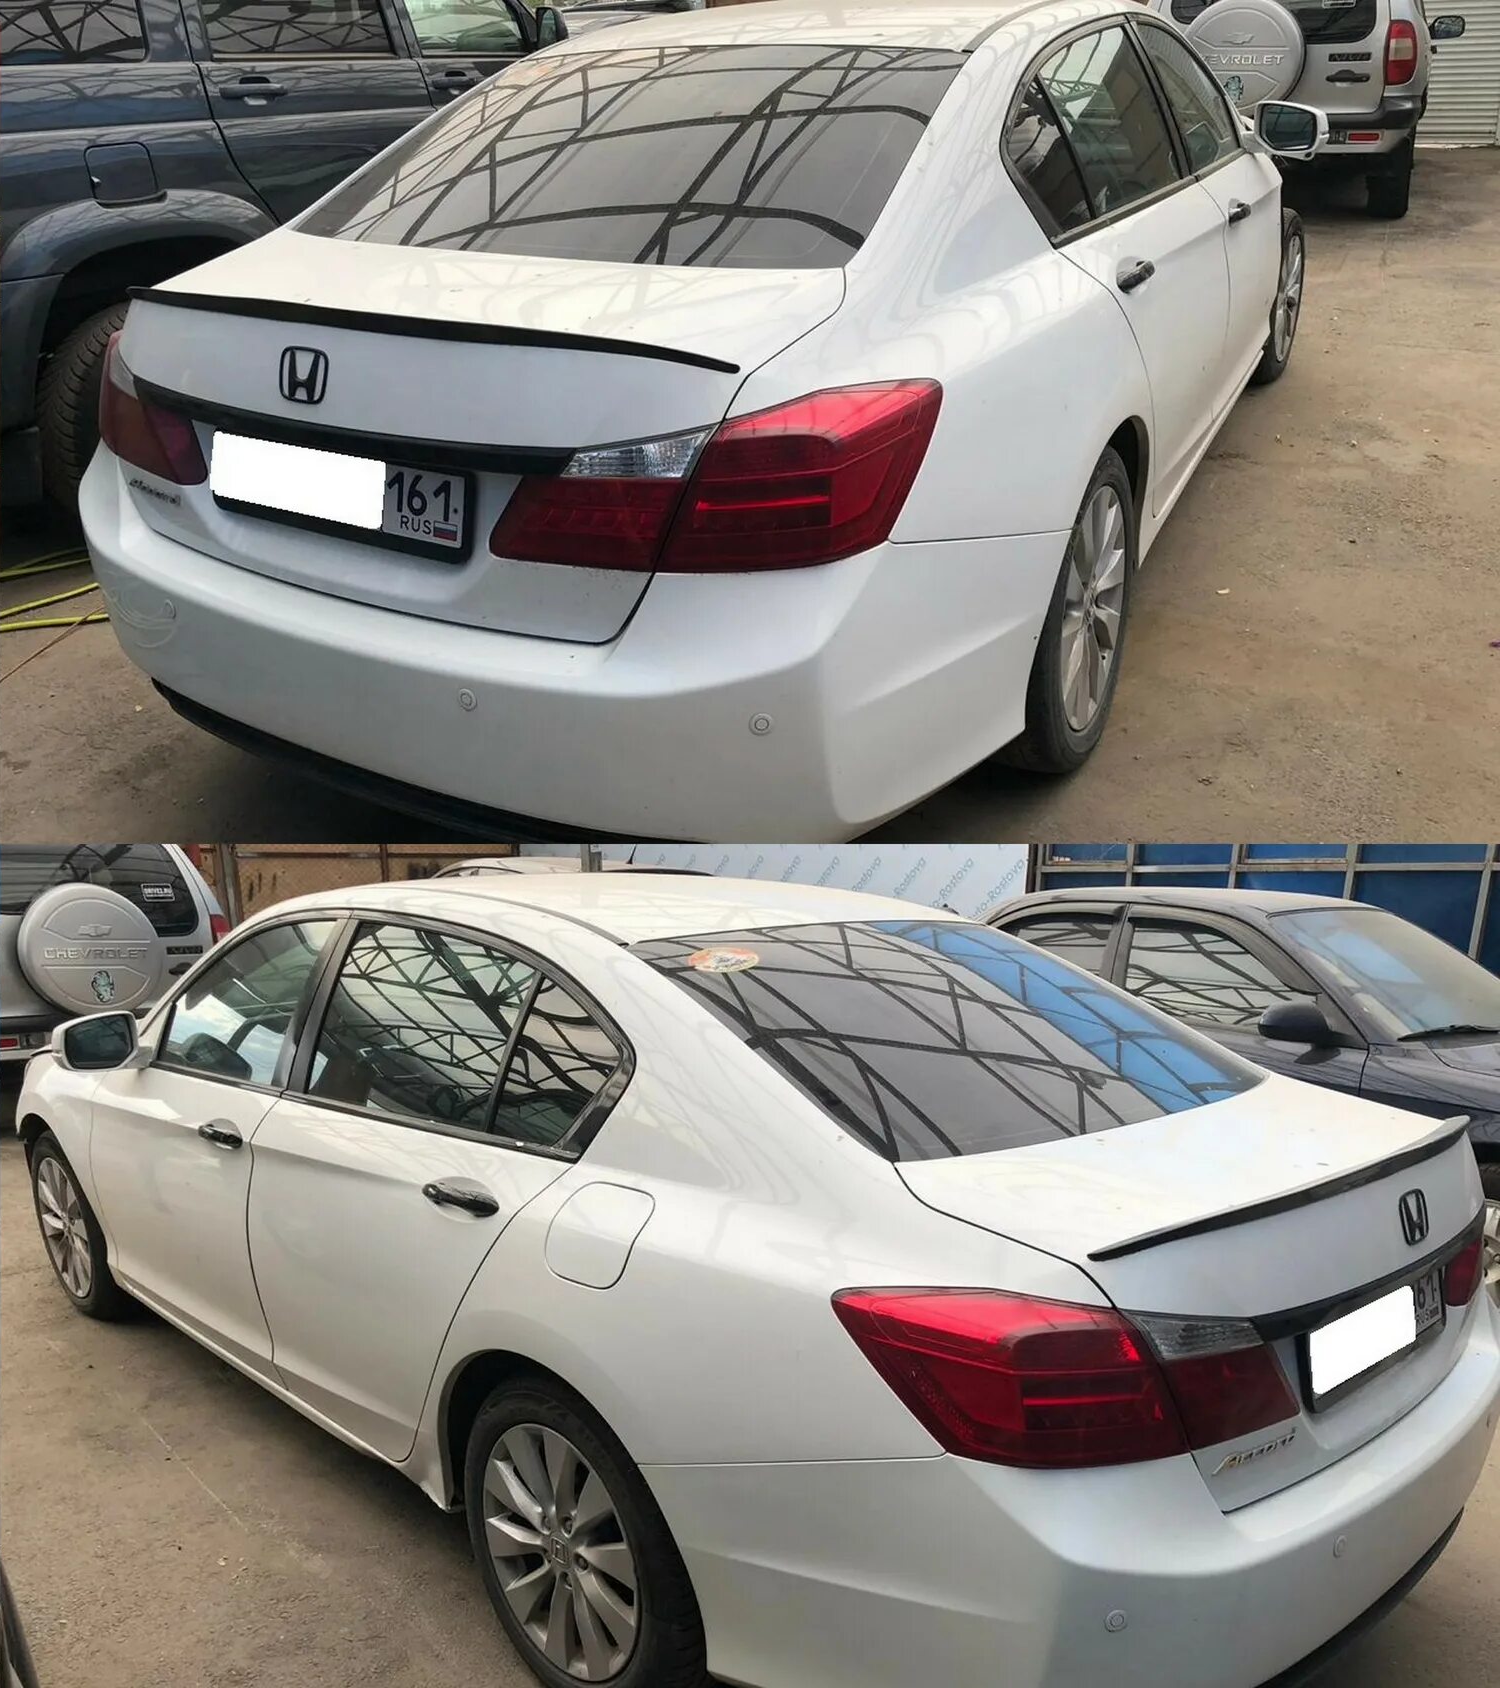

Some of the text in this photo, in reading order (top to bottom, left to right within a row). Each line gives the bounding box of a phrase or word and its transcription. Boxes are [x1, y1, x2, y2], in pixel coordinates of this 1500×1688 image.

[1203, 54, 1284, 65] EVROLET
[387, 471, 451, 521] 161
[400, 514, 432, 534] RUS
[44, 947, 148, 960] CHEVROLET
